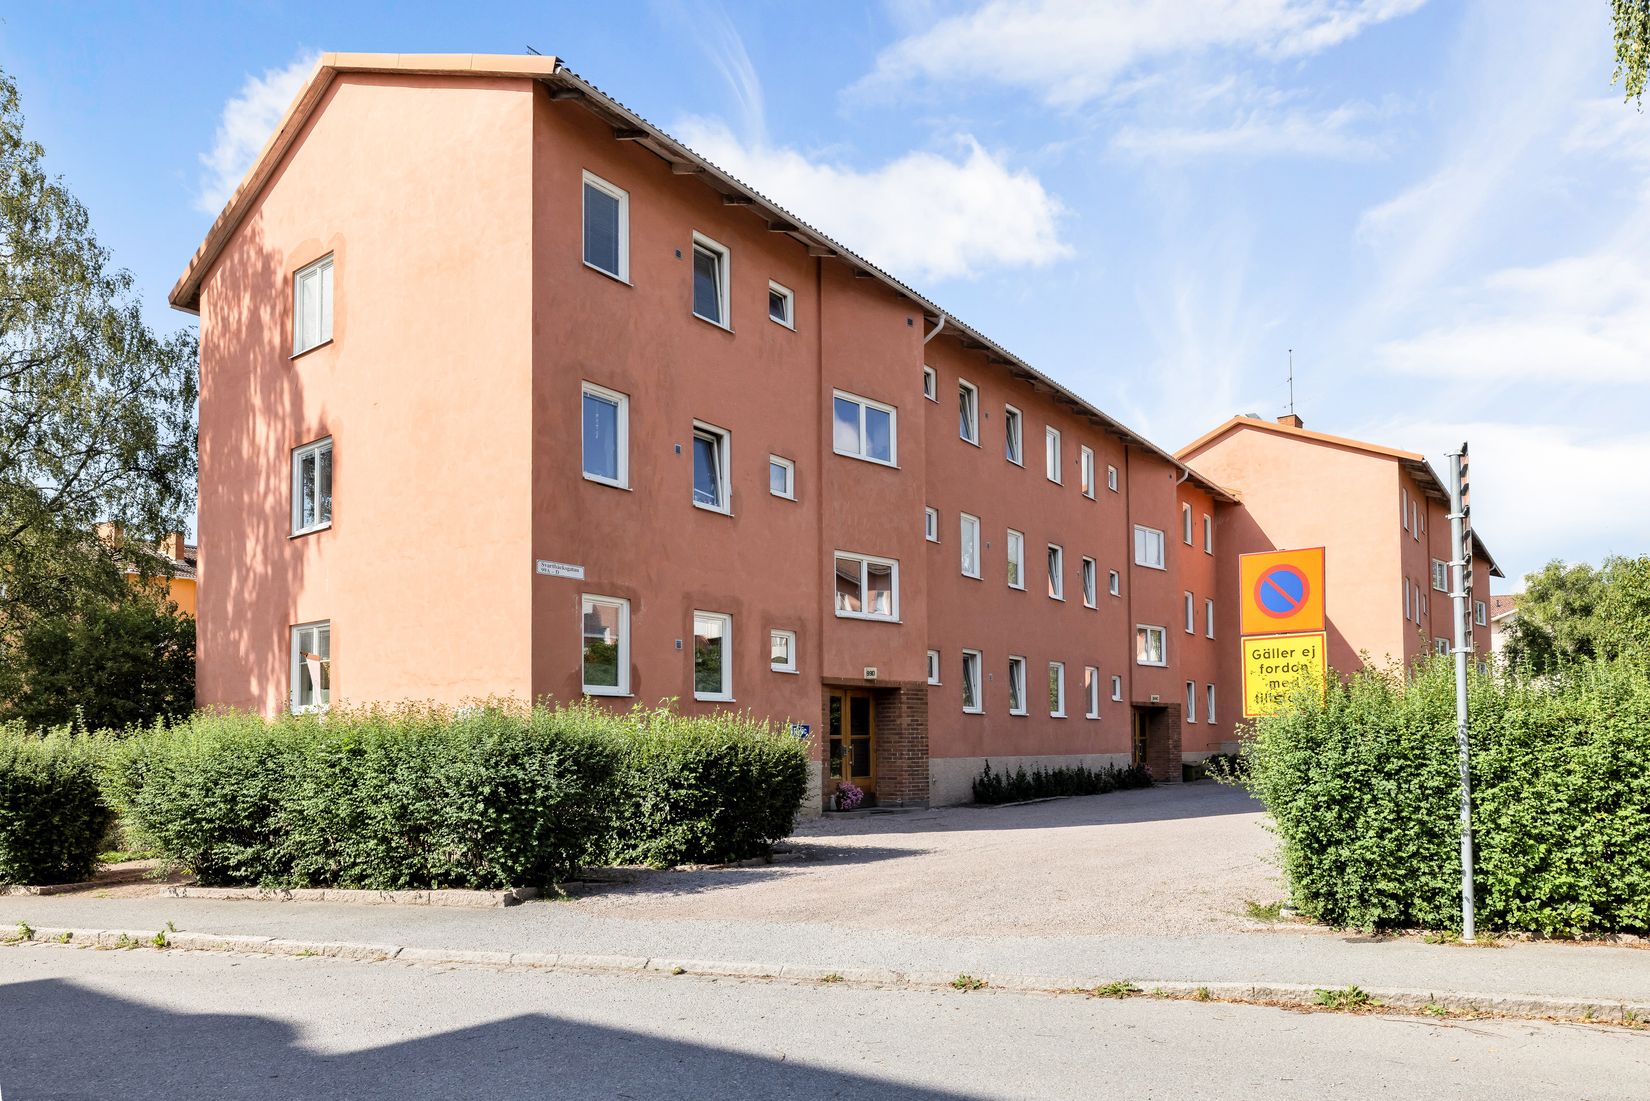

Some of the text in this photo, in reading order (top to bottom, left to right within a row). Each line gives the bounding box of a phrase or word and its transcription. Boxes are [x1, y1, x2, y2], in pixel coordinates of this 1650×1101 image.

[1252, 645, 1316, 660] Gäller ej
[1259, 662, 1309, 674] fordon
